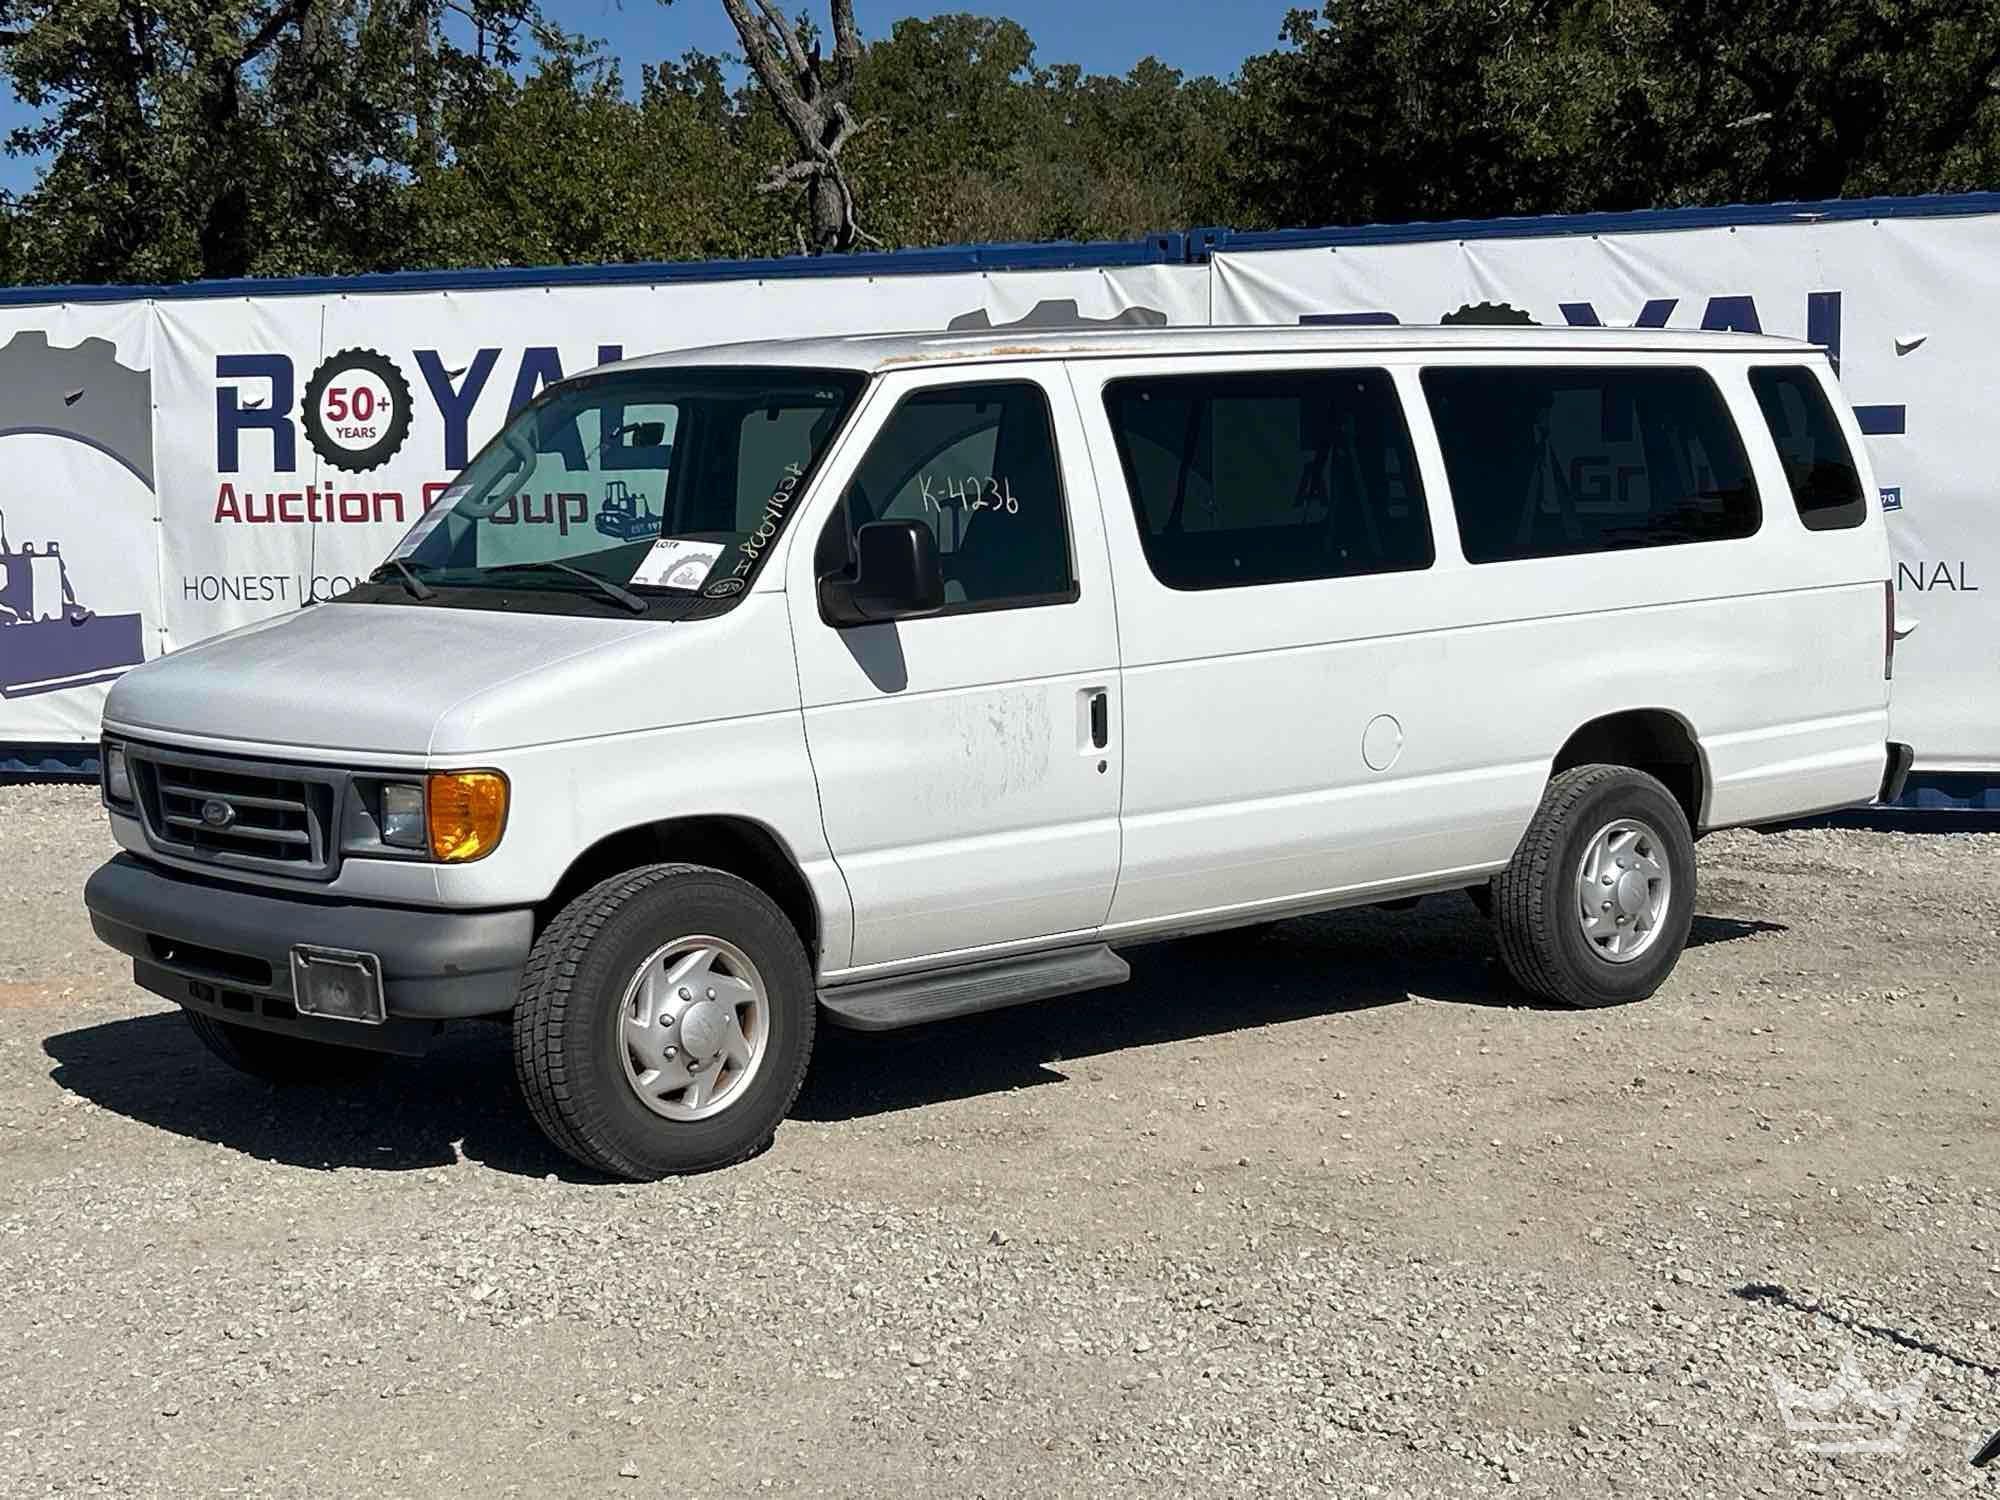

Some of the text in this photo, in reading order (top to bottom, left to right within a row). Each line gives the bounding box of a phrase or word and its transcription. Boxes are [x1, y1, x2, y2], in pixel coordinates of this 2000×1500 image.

[326, 386, 391, 422] 50+
[336, 426, 377, 439] YEARS
[214, 481, 405, 523] Auction
[918, 475, 1019, 514] K-4236
[184, 575, 291, 601] HONEST
